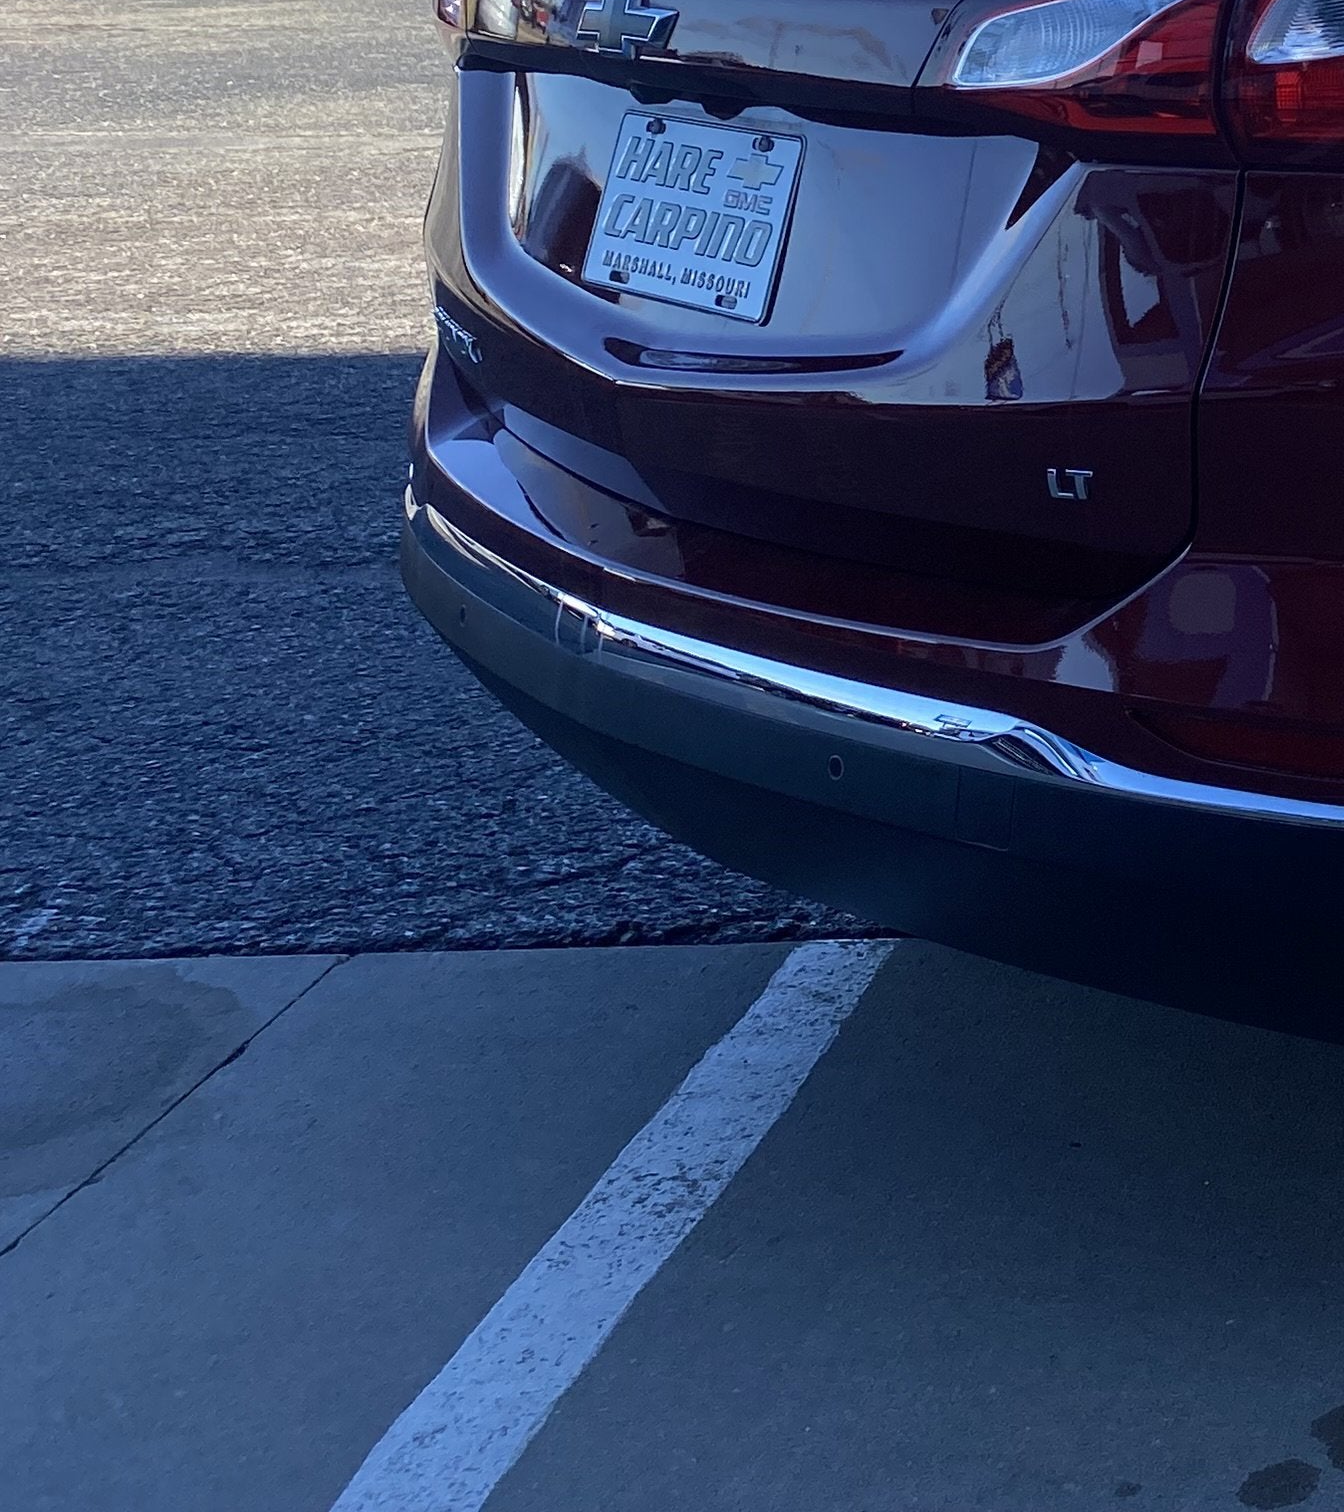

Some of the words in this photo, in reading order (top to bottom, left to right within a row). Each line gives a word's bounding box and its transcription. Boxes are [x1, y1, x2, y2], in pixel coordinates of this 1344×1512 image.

[616, 135, 724, 195] HARE
[723, 189, 773, 216] GMC
[603, 193, 773, 268] CARPINO
[602, 249, 677, 286] MARSHALL,
[680, 267, 752, 300] MISSOURI
[1046, 468, 1094, 500] LT
